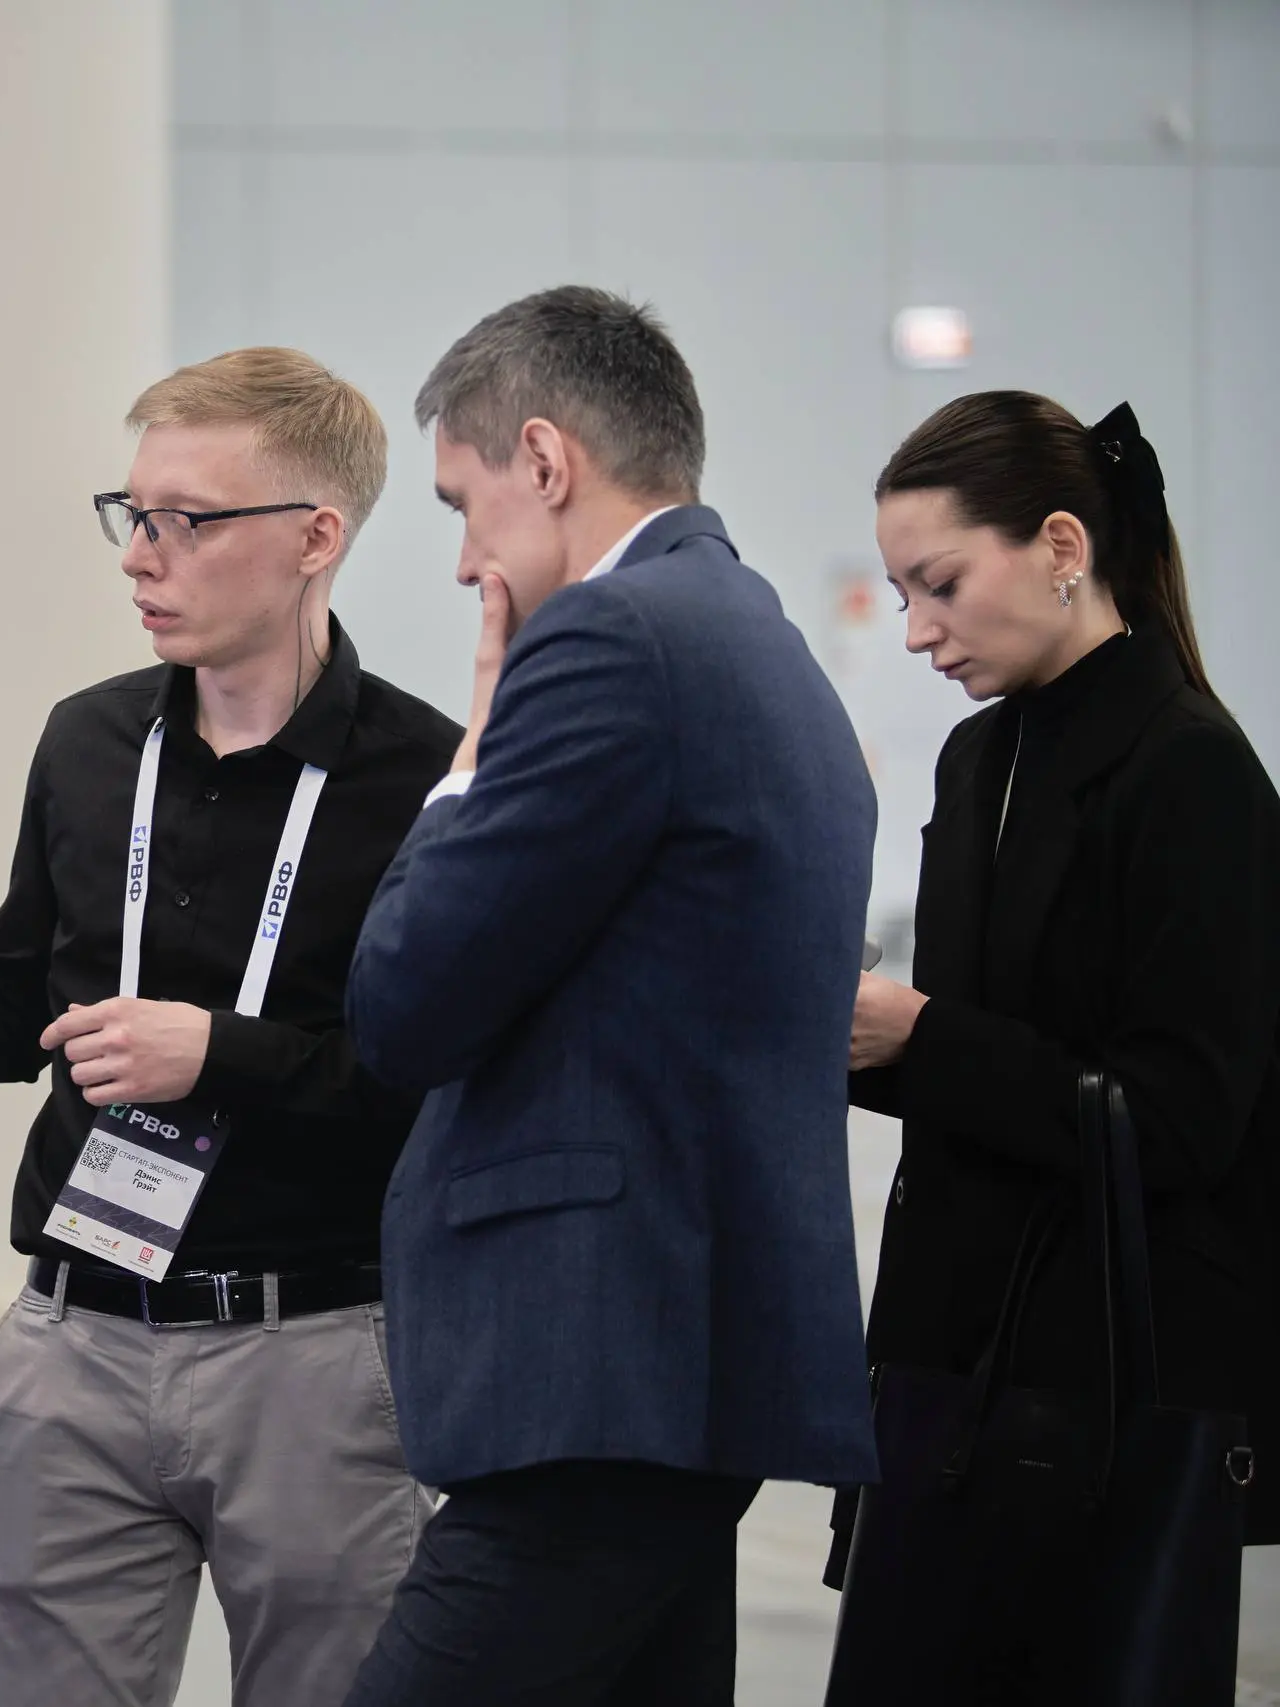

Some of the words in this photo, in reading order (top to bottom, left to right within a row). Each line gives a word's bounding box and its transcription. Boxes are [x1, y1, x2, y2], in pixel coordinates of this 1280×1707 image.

[129, 847, 145, 902] РВФ
[268, 861, 293, 917] РВФ
[128, 1109, 181, 1140] РВФ
[119, 1150, 189, 1184] СТАРТАП-ЭКСПОНЕНТ
[134, 1169, 162, 1185] Дэнис
[132, 1178, 157, 1193] Грэйт
